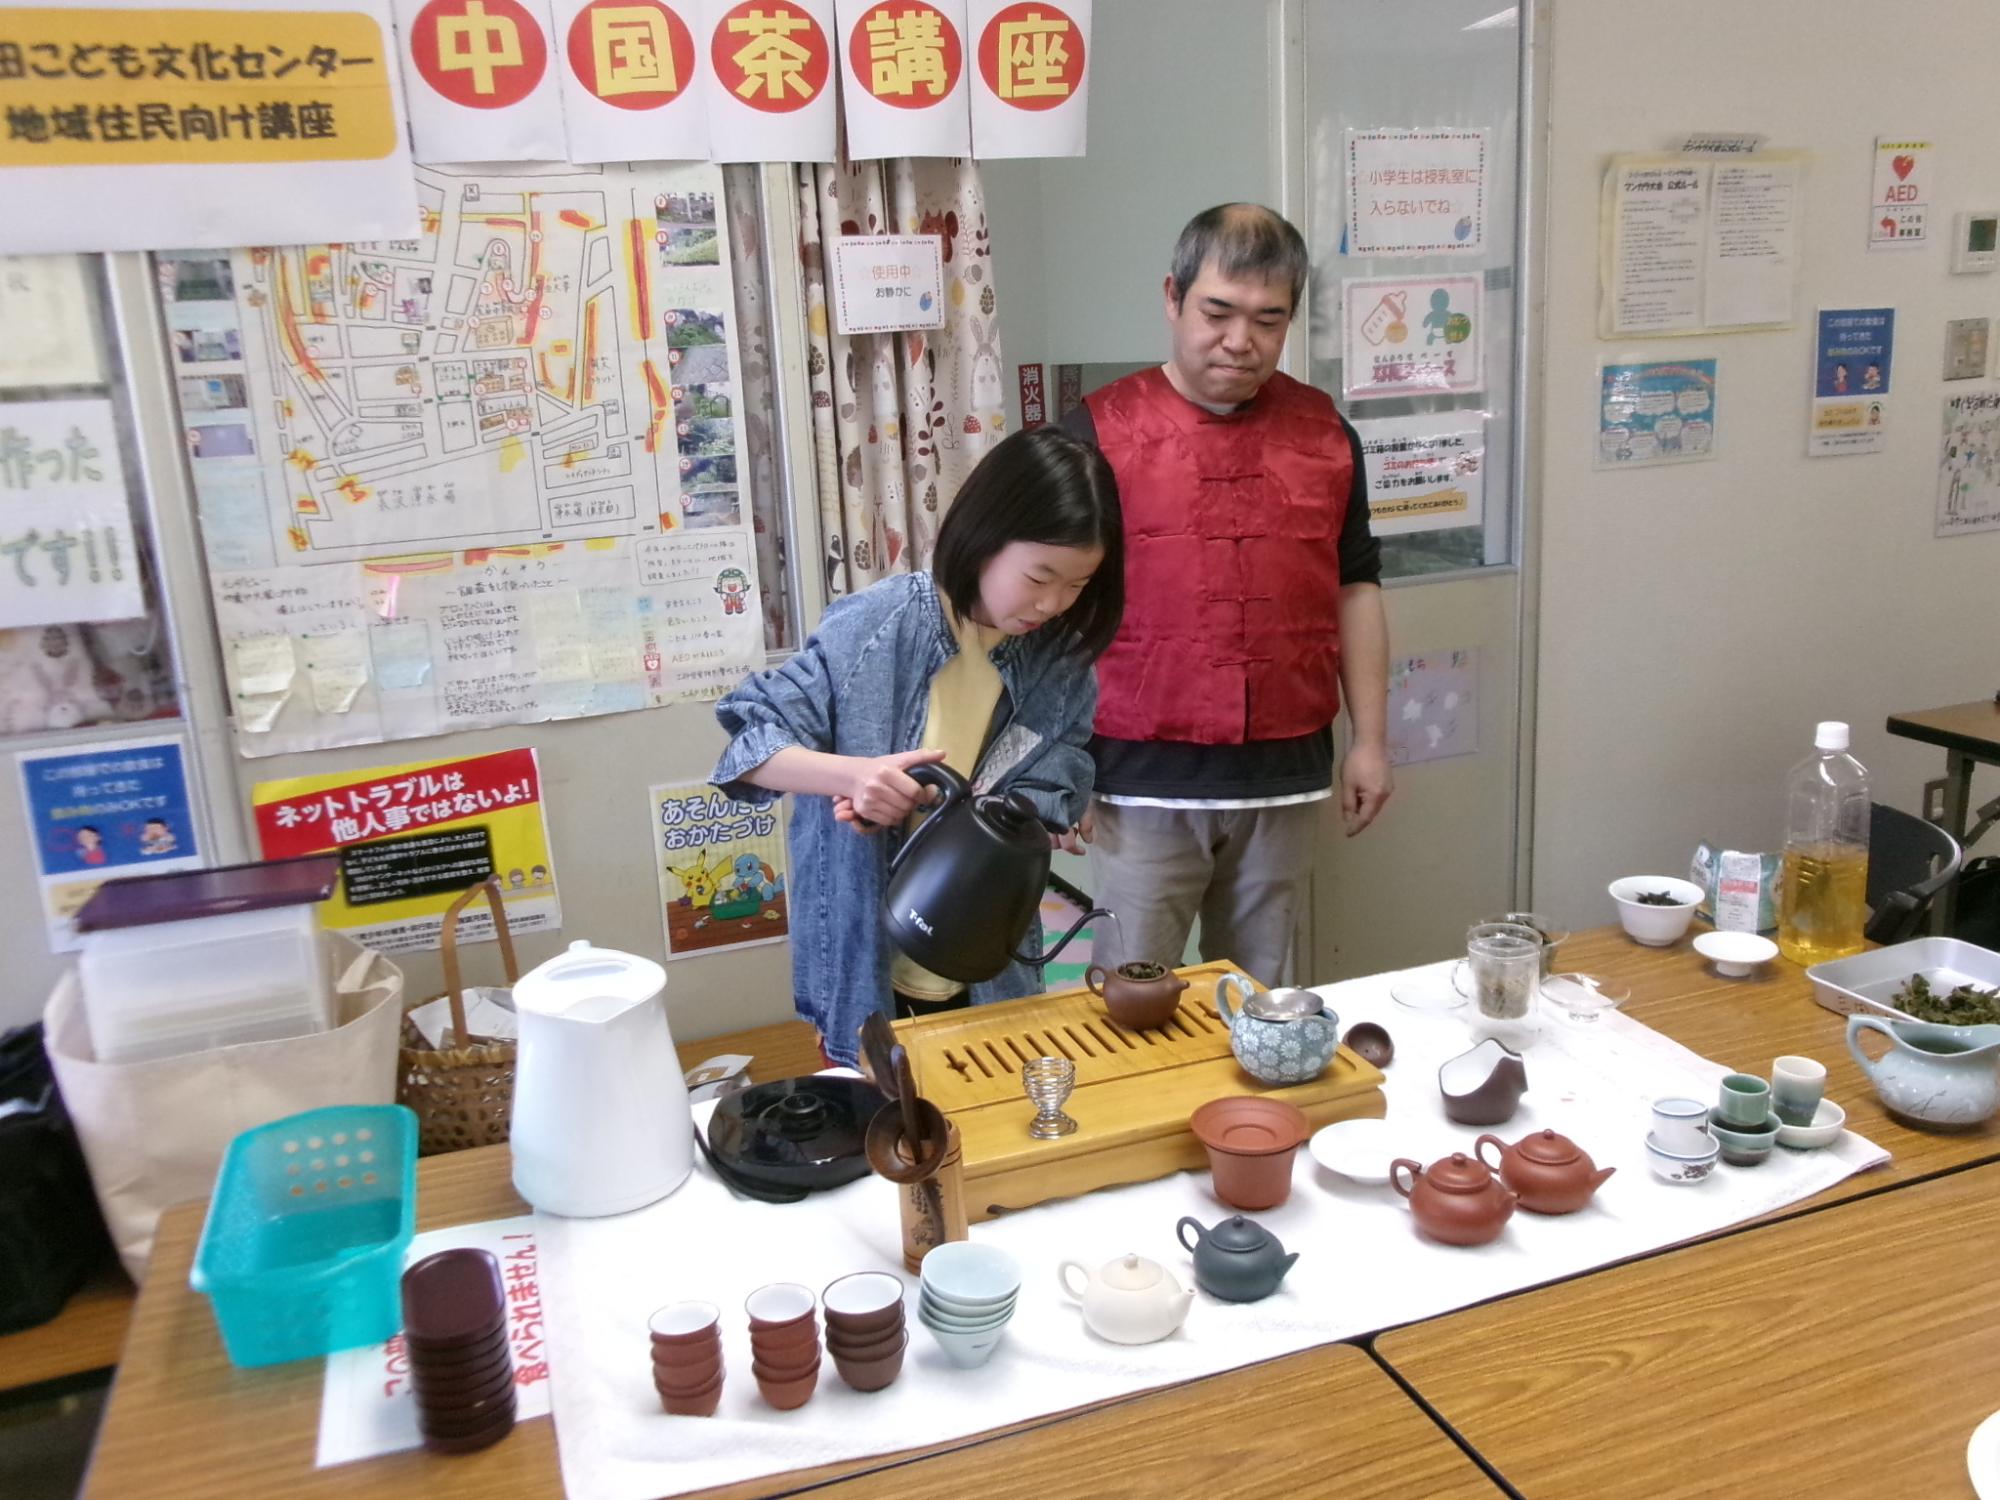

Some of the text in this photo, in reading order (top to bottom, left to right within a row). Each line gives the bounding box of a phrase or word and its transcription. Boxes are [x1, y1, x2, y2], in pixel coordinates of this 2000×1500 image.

[437, 0, 1071, 100] 中国茶講座
[7, 101, 338, 142] 地域住民向け講座
[1369, 168, 1478, 186] 小学生は授乳室に
[1885, 185, 1918, 202] AED
[1370, 199, 1451, 216] 入らないでね
[873, 265, 912, 280] 使用中
[875, 286, 912, 298] お静かに
[1023, 366, 1042, 422] 消火器
[275, 771, 464, 828] ネットトラブルは
[330, 778, 532, 843] 他人事ではないよ!
[665, 816, 777, 850] おかたづけ
[502, 1232, 549, 1388] 食べられません!
